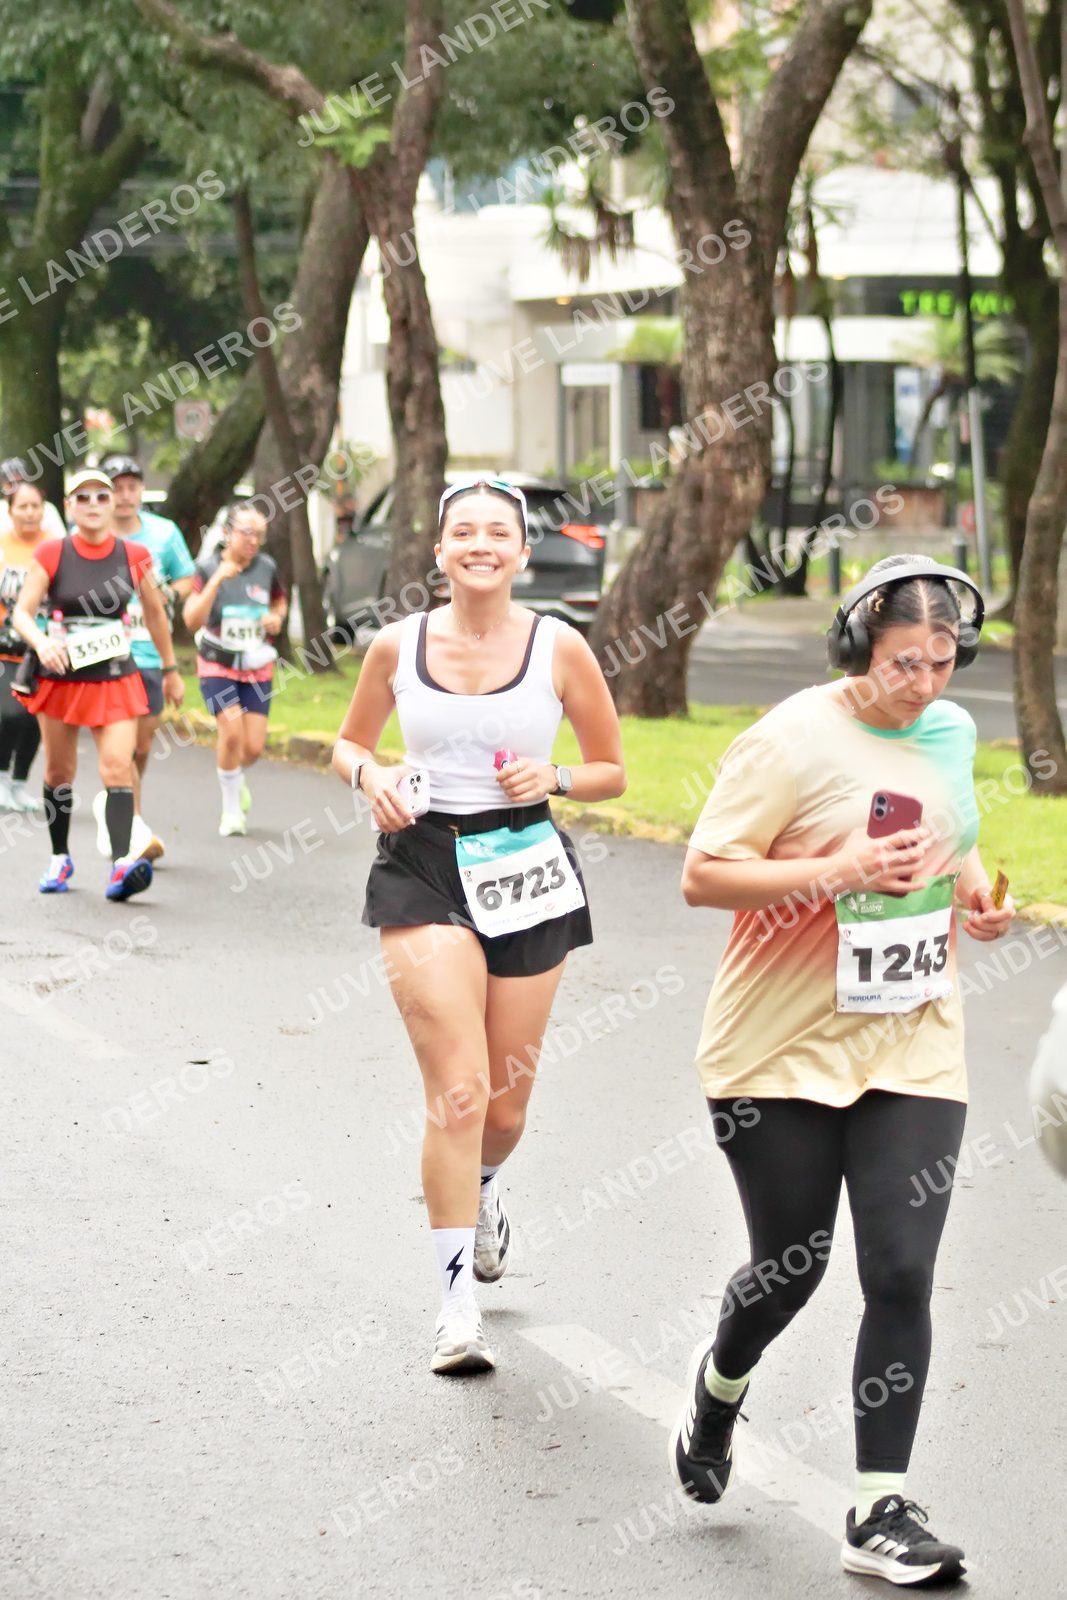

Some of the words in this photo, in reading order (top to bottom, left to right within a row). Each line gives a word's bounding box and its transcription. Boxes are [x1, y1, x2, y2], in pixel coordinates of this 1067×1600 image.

[74, 633, 121, 659] 3550
[476, 856, 566, 911] 6723
[852, 933, 949, 983] 1243
[847, 993, 882, 1003] PERDURA
